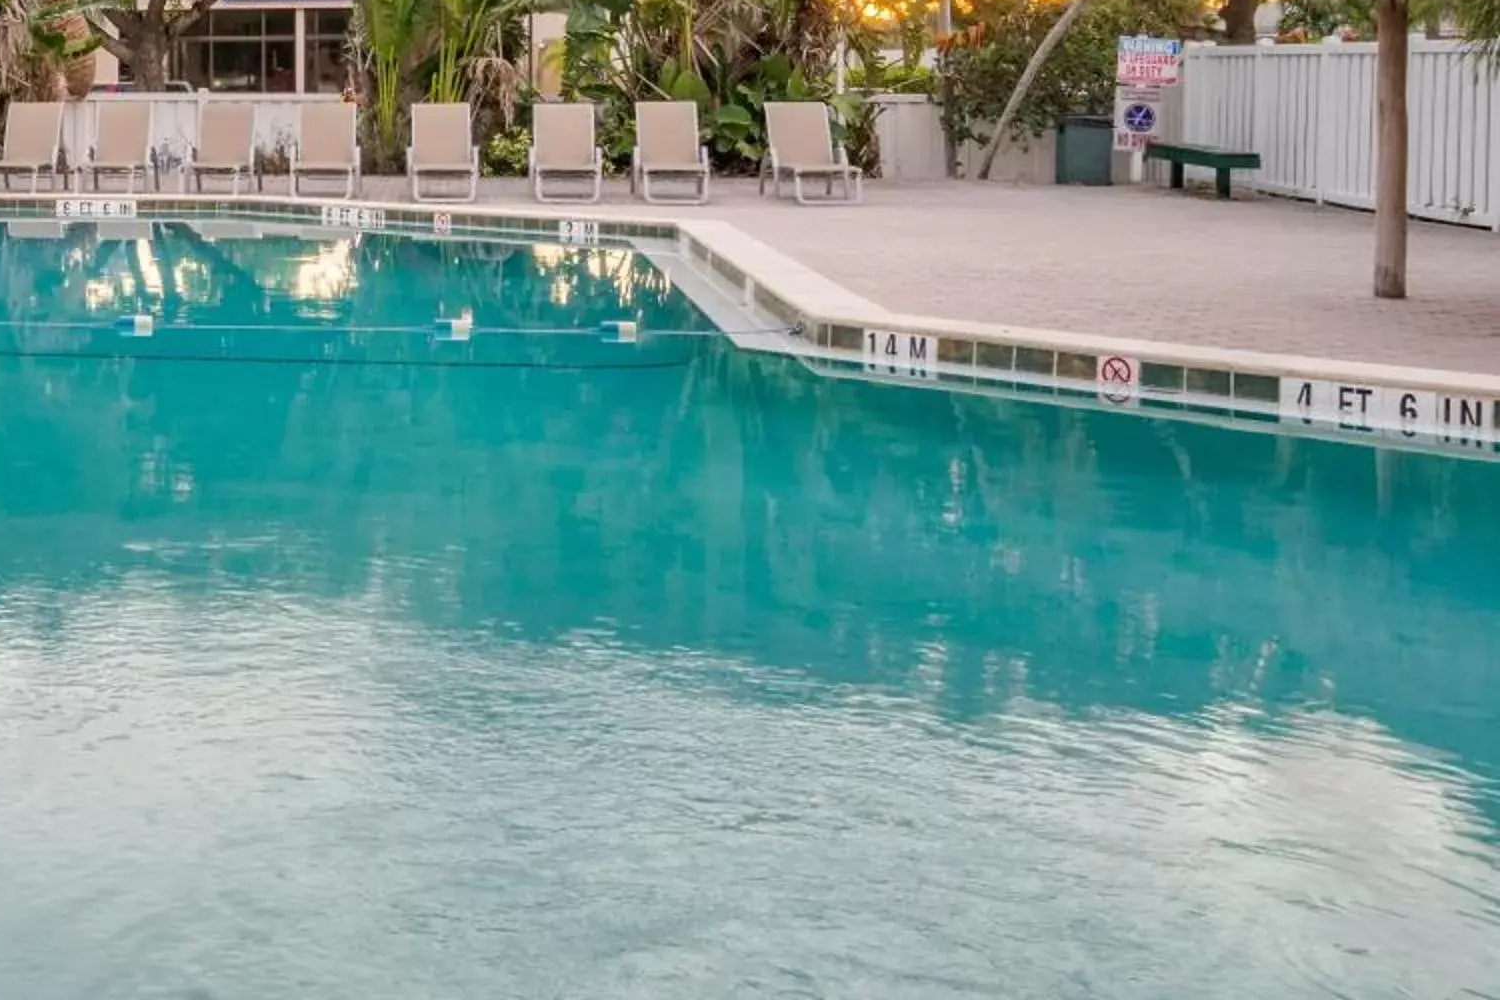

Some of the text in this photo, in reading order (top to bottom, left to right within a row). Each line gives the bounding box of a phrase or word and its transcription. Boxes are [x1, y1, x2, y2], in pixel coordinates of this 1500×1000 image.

[909, 335, 927, 360] M
[1338, 386, 1373, 414] FT
[1400, 393, 1418, 419] 6
[1444, 397, 1483, 427] IN
